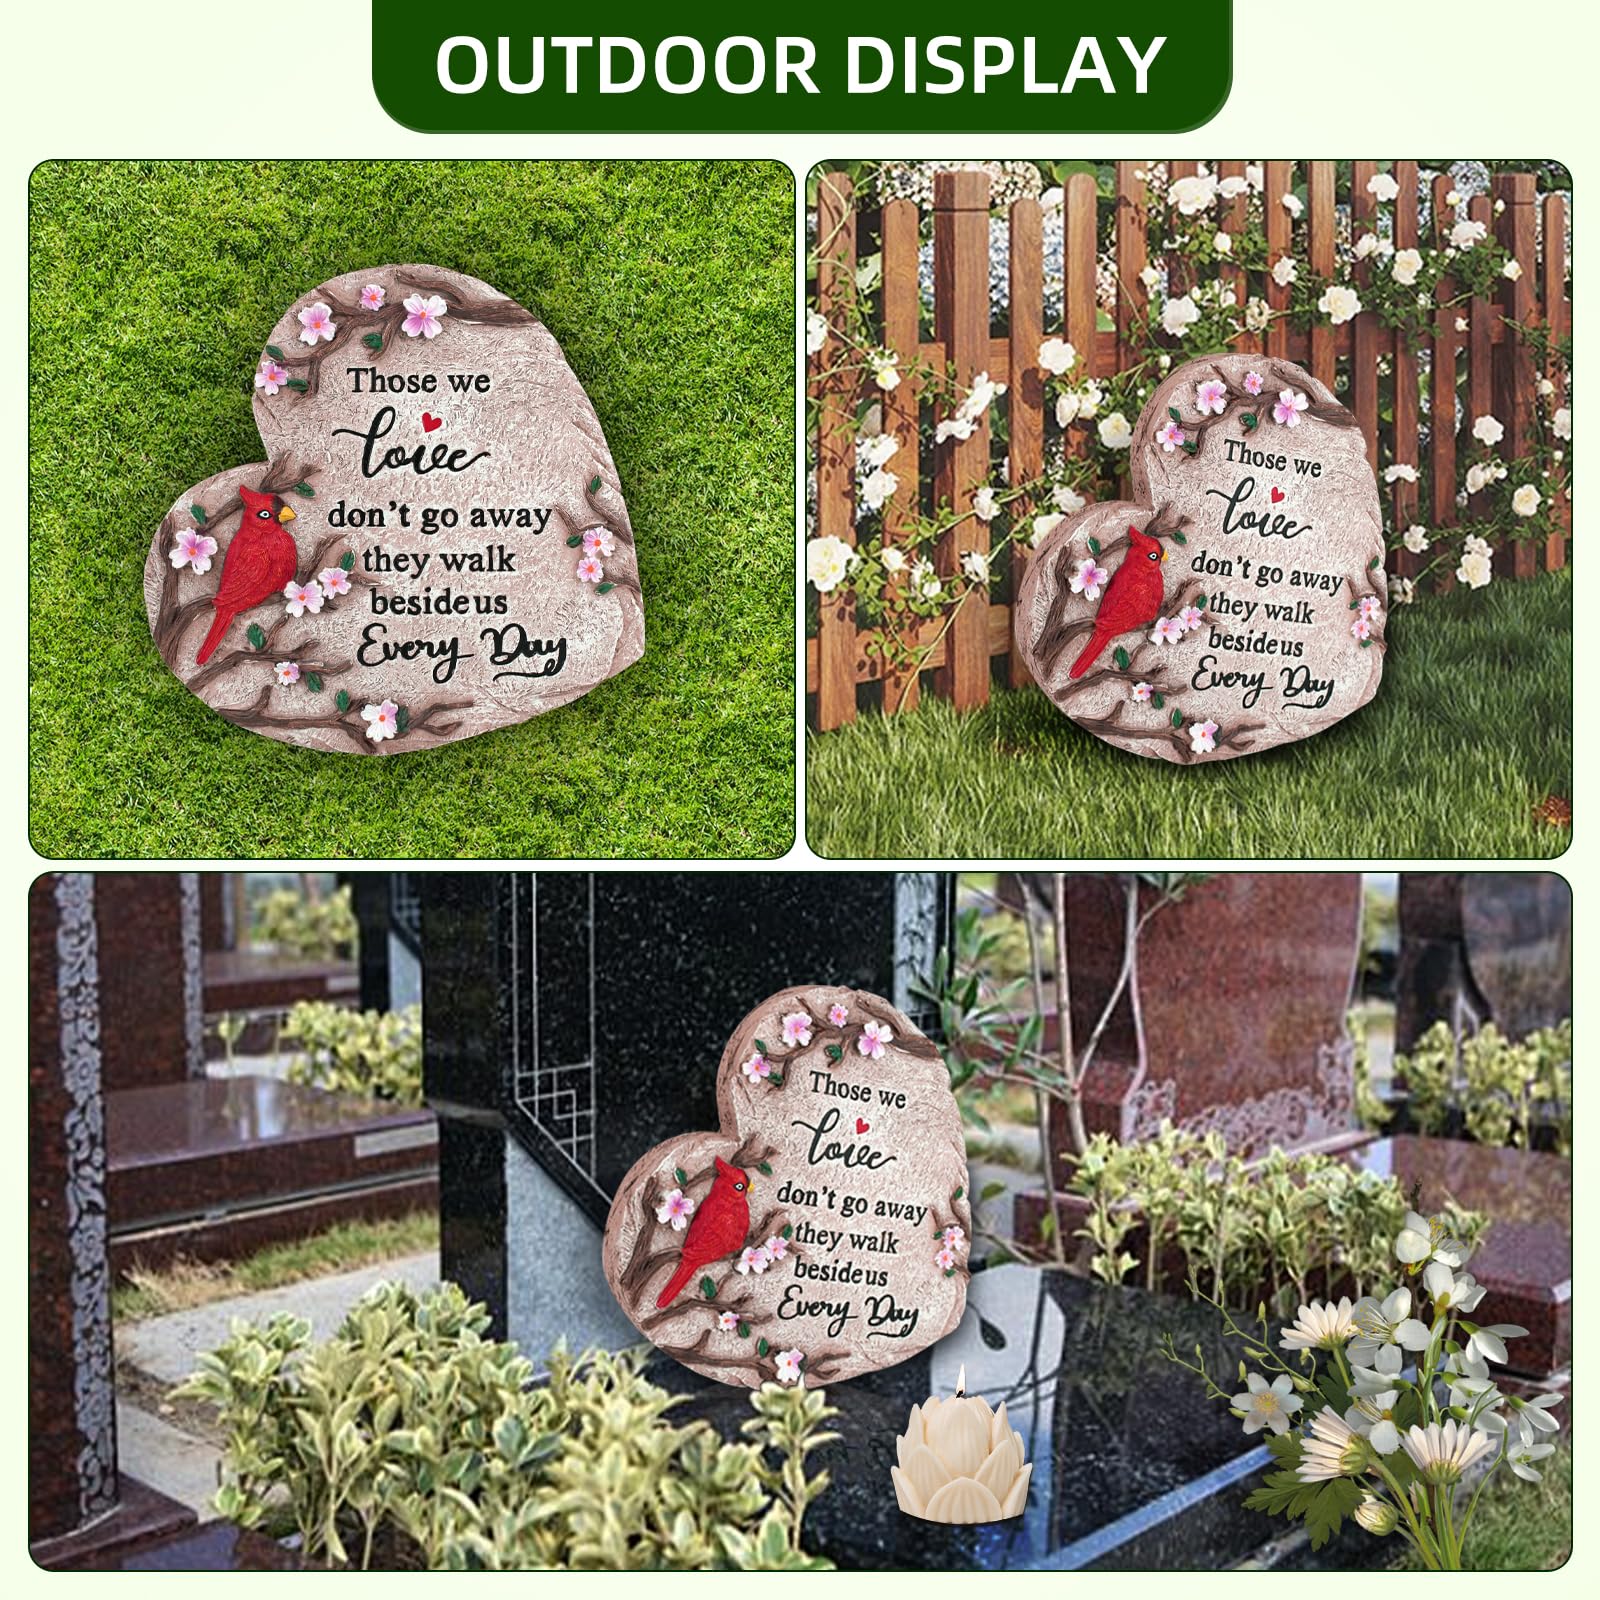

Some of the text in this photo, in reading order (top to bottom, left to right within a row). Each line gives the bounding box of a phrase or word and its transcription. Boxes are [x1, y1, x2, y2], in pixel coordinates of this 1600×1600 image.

[346, 367, 490, 393] Those we
[1224, 439, 1322, 477] Those we
[422, 507, 458, 535] go
[471, 508, 552, 535] away
[362, 545, 516, 578] they walk
[1255, 565, 1283, 587] go
[1290, 570, 1343, 596] away
[1209, 592, 1314, 624] they walk
[357, 623, 567, 684] Every Day
[1192, 655, 1334, 710] Every Day
[809, 1071, 906, 1109] Those we
[840, 1195, 868, 1217] go
[875, 1200, 928, 1226] away
[795, 1222, 899, 1254] they walk
[777, 1284, 918, 1339] Every Day
